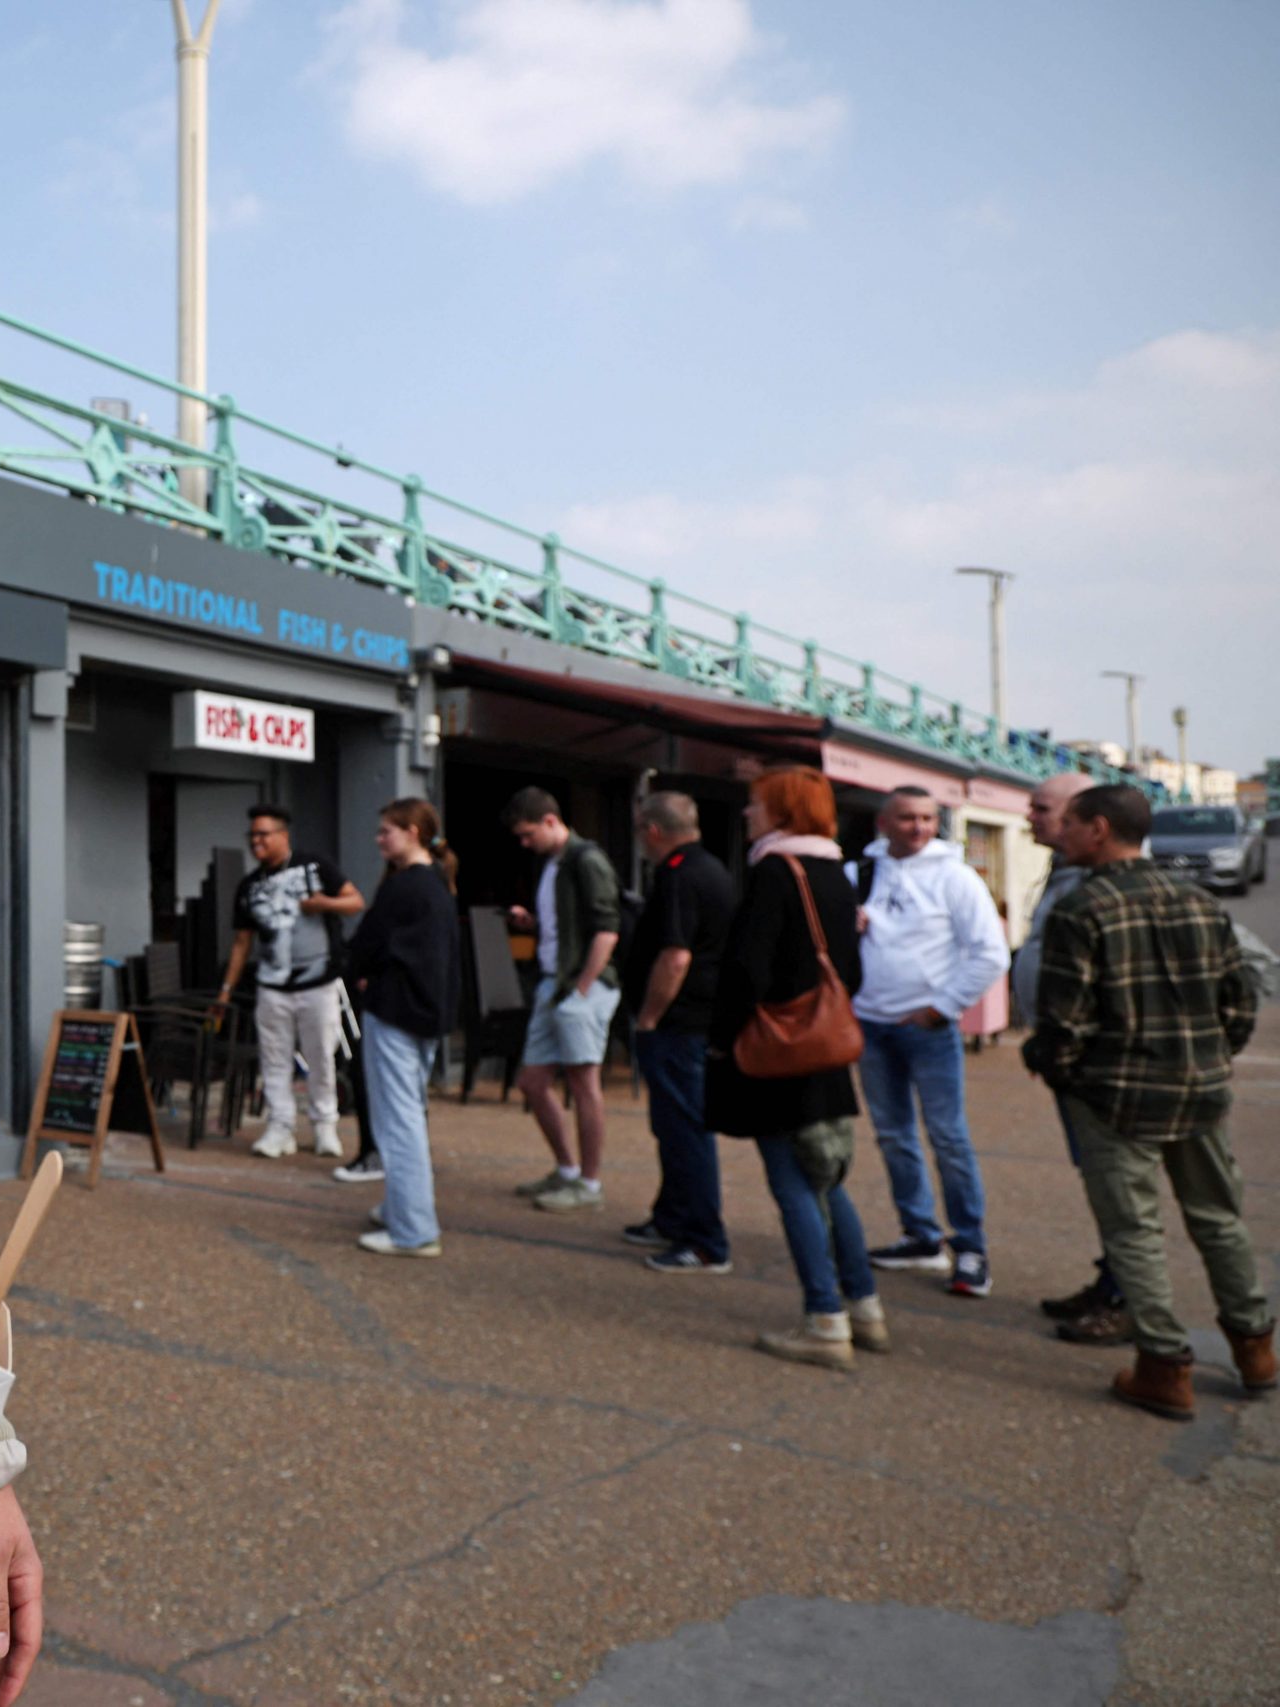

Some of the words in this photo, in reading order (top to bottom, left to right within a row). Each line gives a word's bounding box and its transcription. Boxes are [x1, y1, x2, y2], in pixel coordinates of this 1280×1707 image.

[93, 560, 263, 635] TRADITIONAL
[278, 608, 327, 650] FISH
[331, 622, 349, 653] &
[352, 627, 409, 668] CHIPS
[205, 703, 241, 740] FISH
